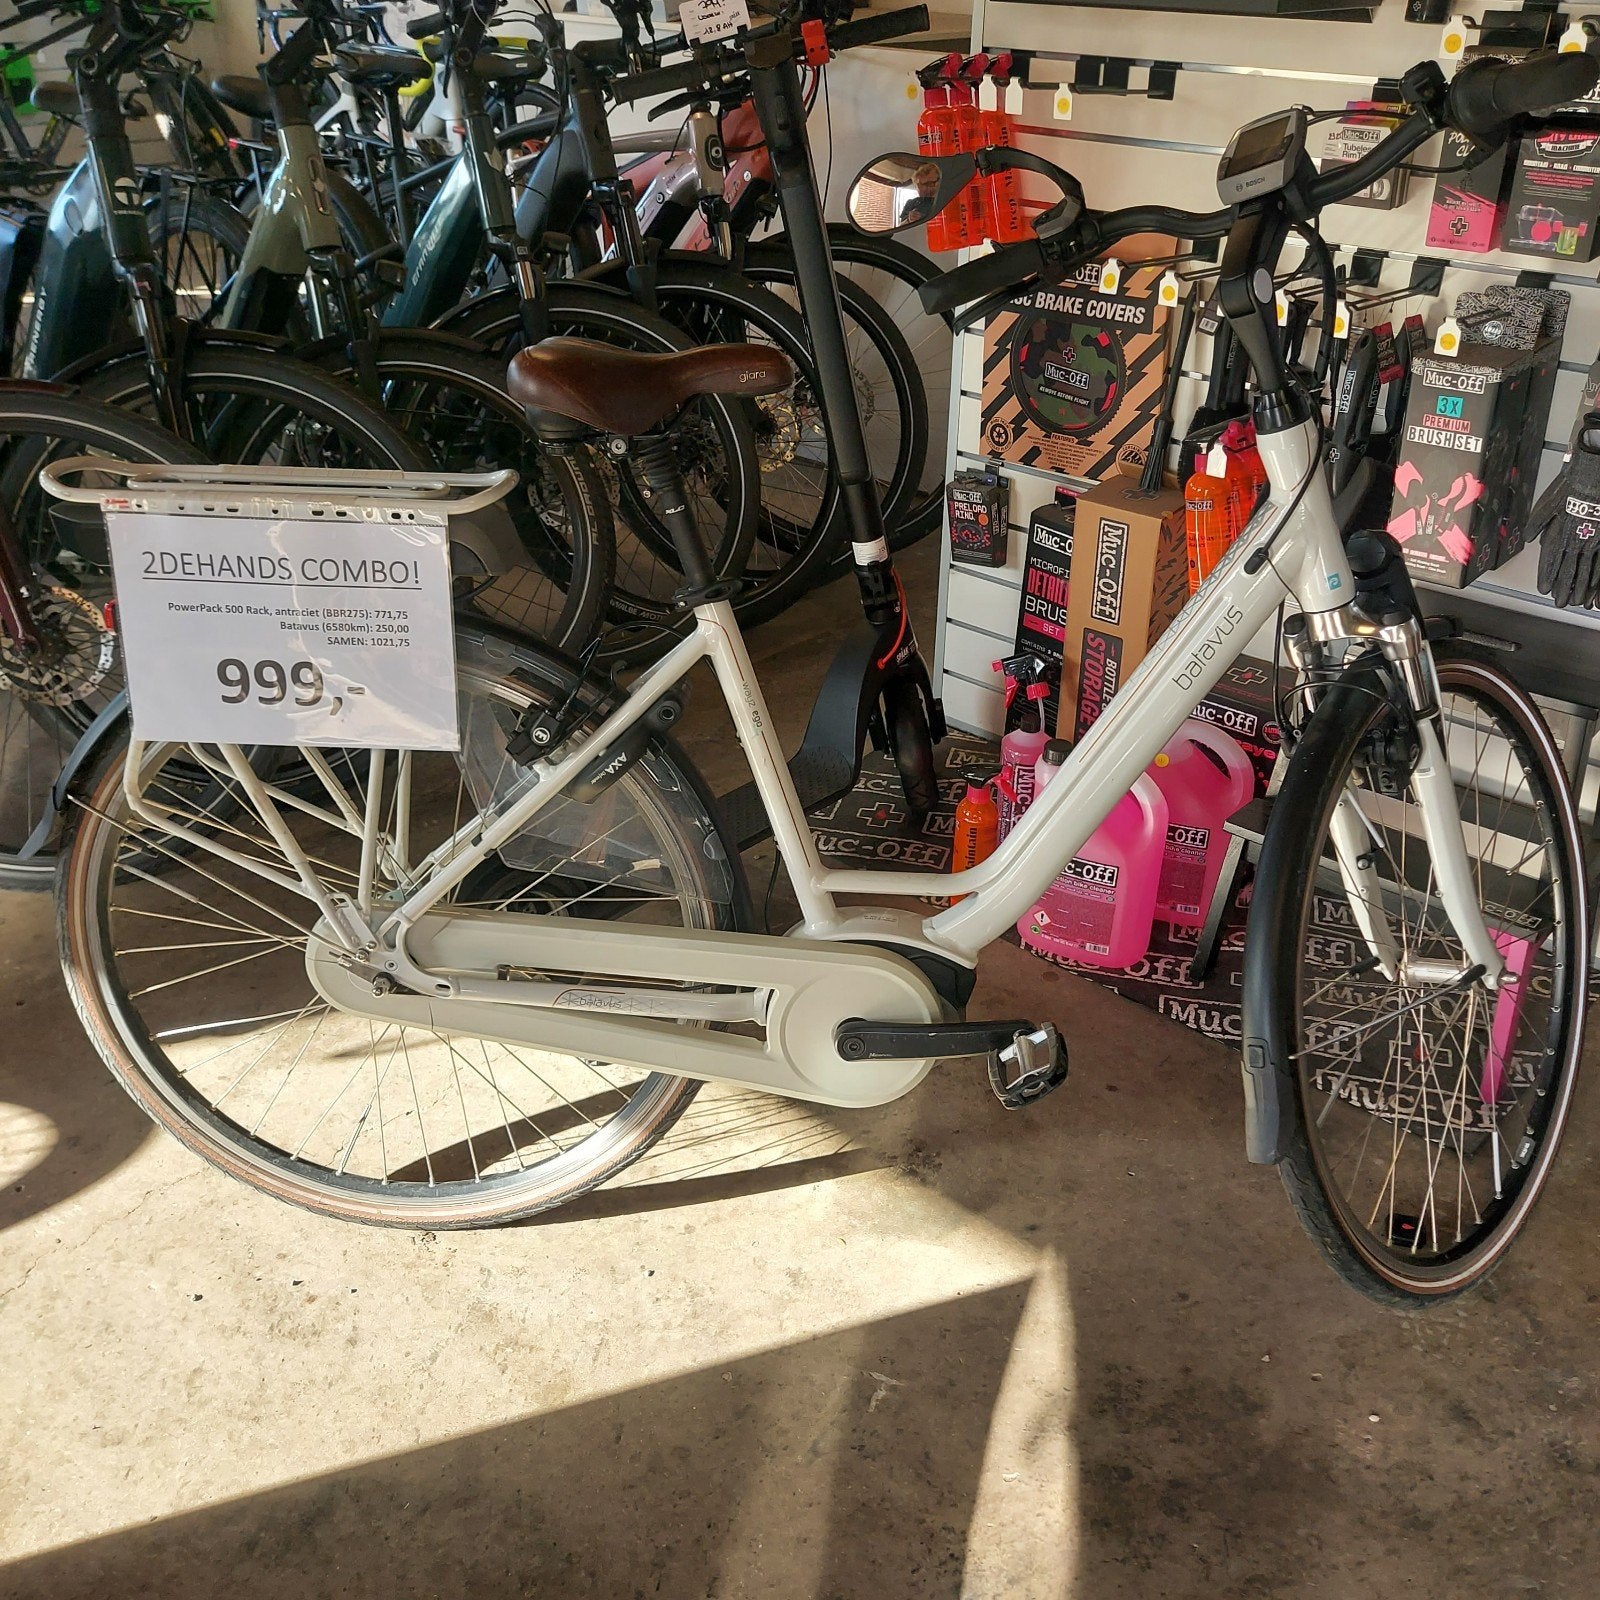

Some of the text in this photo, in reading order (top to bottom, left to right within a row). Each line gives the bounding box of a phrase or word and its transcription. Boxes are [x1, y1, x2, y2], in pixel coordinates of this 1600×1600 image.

[1343, 128, 1381, 141] Muc-Off
[1245, 177, 1266, 188] BOSCH
[1034, 291, 1084, 316] BRAKE
[1085, 300, 1147, 325] COVERS
[739, 369, 767, 384] giara
[1046, 364, 1090, 387] Muc-Off
[1425, 371, 1484, 393] Muc-Off
[1057, 390, 1074, 401] BEFORE
[1340, 371, 1356, 413] Muc-Off
[1424, 414, 1470, 432] PREMIUM
[1051, 433, 1076, 444] FEATURES
[1408, 427, 1482, 452] BRUSH SET
[954, 491, 981, 502] Muc-Off
[954, 502, 988, 514] PRELOAD
[142, 550, 421, 585] 2DEHANDS COMBO!
[1094, 523, 1123, 620] Muc-Off
[168, 602, 409, 622] PowerPack 500 Rack, antraciet (BBR275): 771,75
[280, 621, 410, 635] Batavus (6580km): 250,00
[1042, 622, 1060, 637] SET
[327, 636, 410, 648] SAMEN: 1021,75
[1172, 604, 1244, 691] batavus
[216, 658, 367, 717] 999,-
[1079, 632, 1106, 724] STORAGE
[1103, 658, 1118, 705] BOTTLE
[741, 681, 764, 729] wayz ego
[603, 751, 628, 774] AXA
[1075, 879, 1088, 889] bike
[1087, 882, 1115, 896] cleaner
